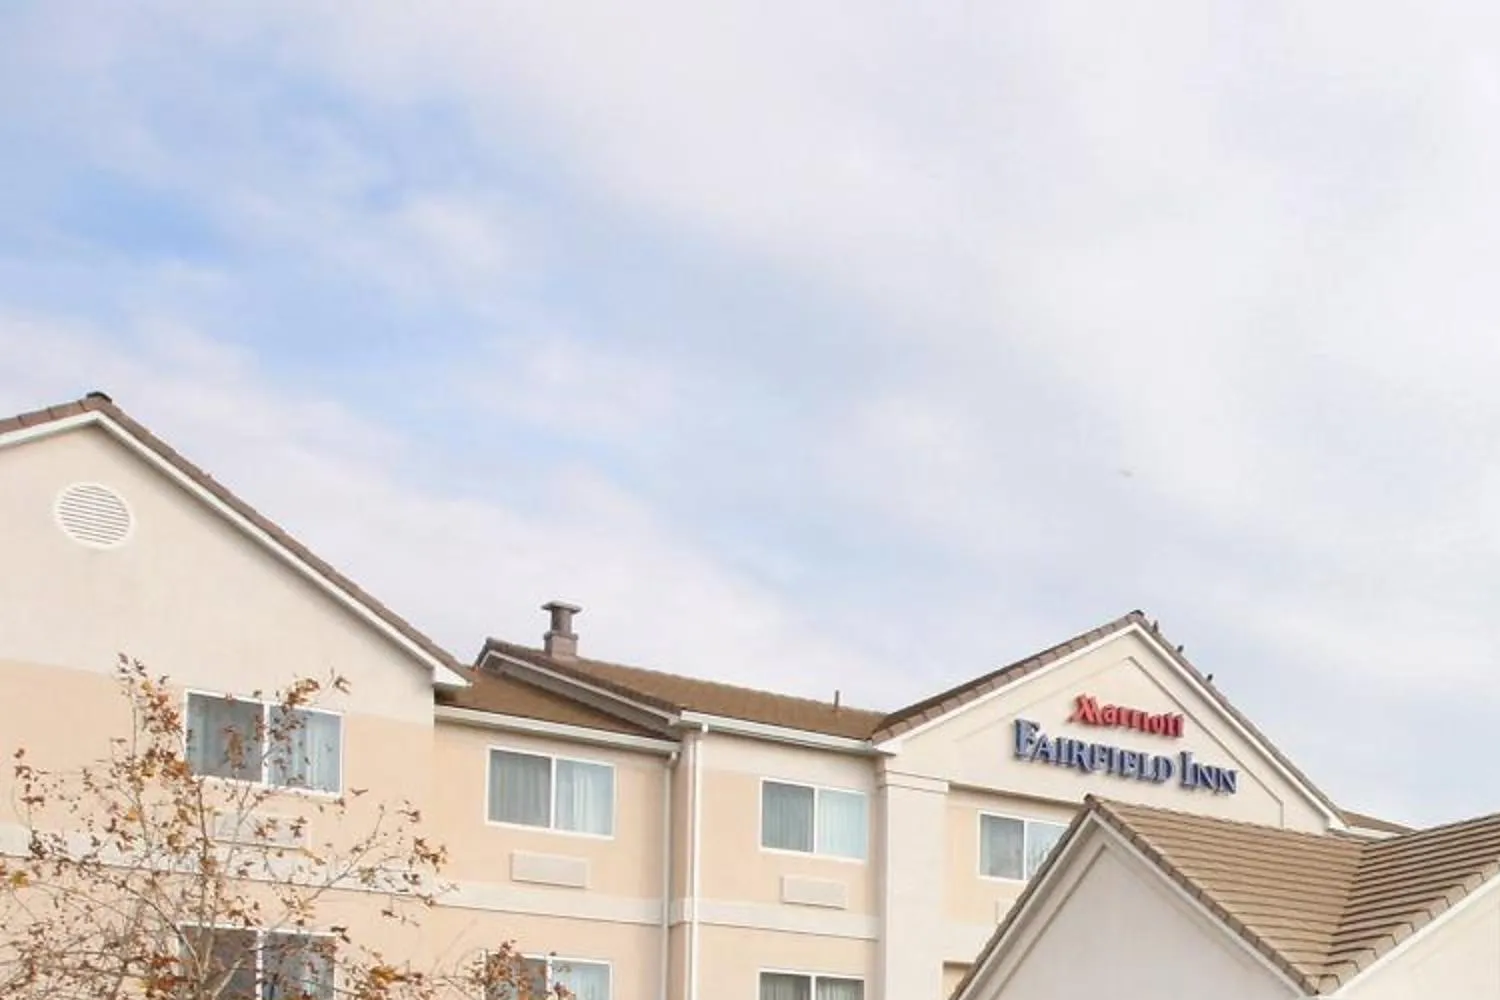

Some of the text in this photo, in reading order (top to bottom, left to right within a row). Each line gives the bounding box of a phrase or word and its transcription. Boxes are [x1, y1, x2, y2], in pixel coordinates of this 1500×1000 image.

[1067, 693, 1185, 738] Marriott
[1013, 718, 1238, 795] FAIRFIELD INN
